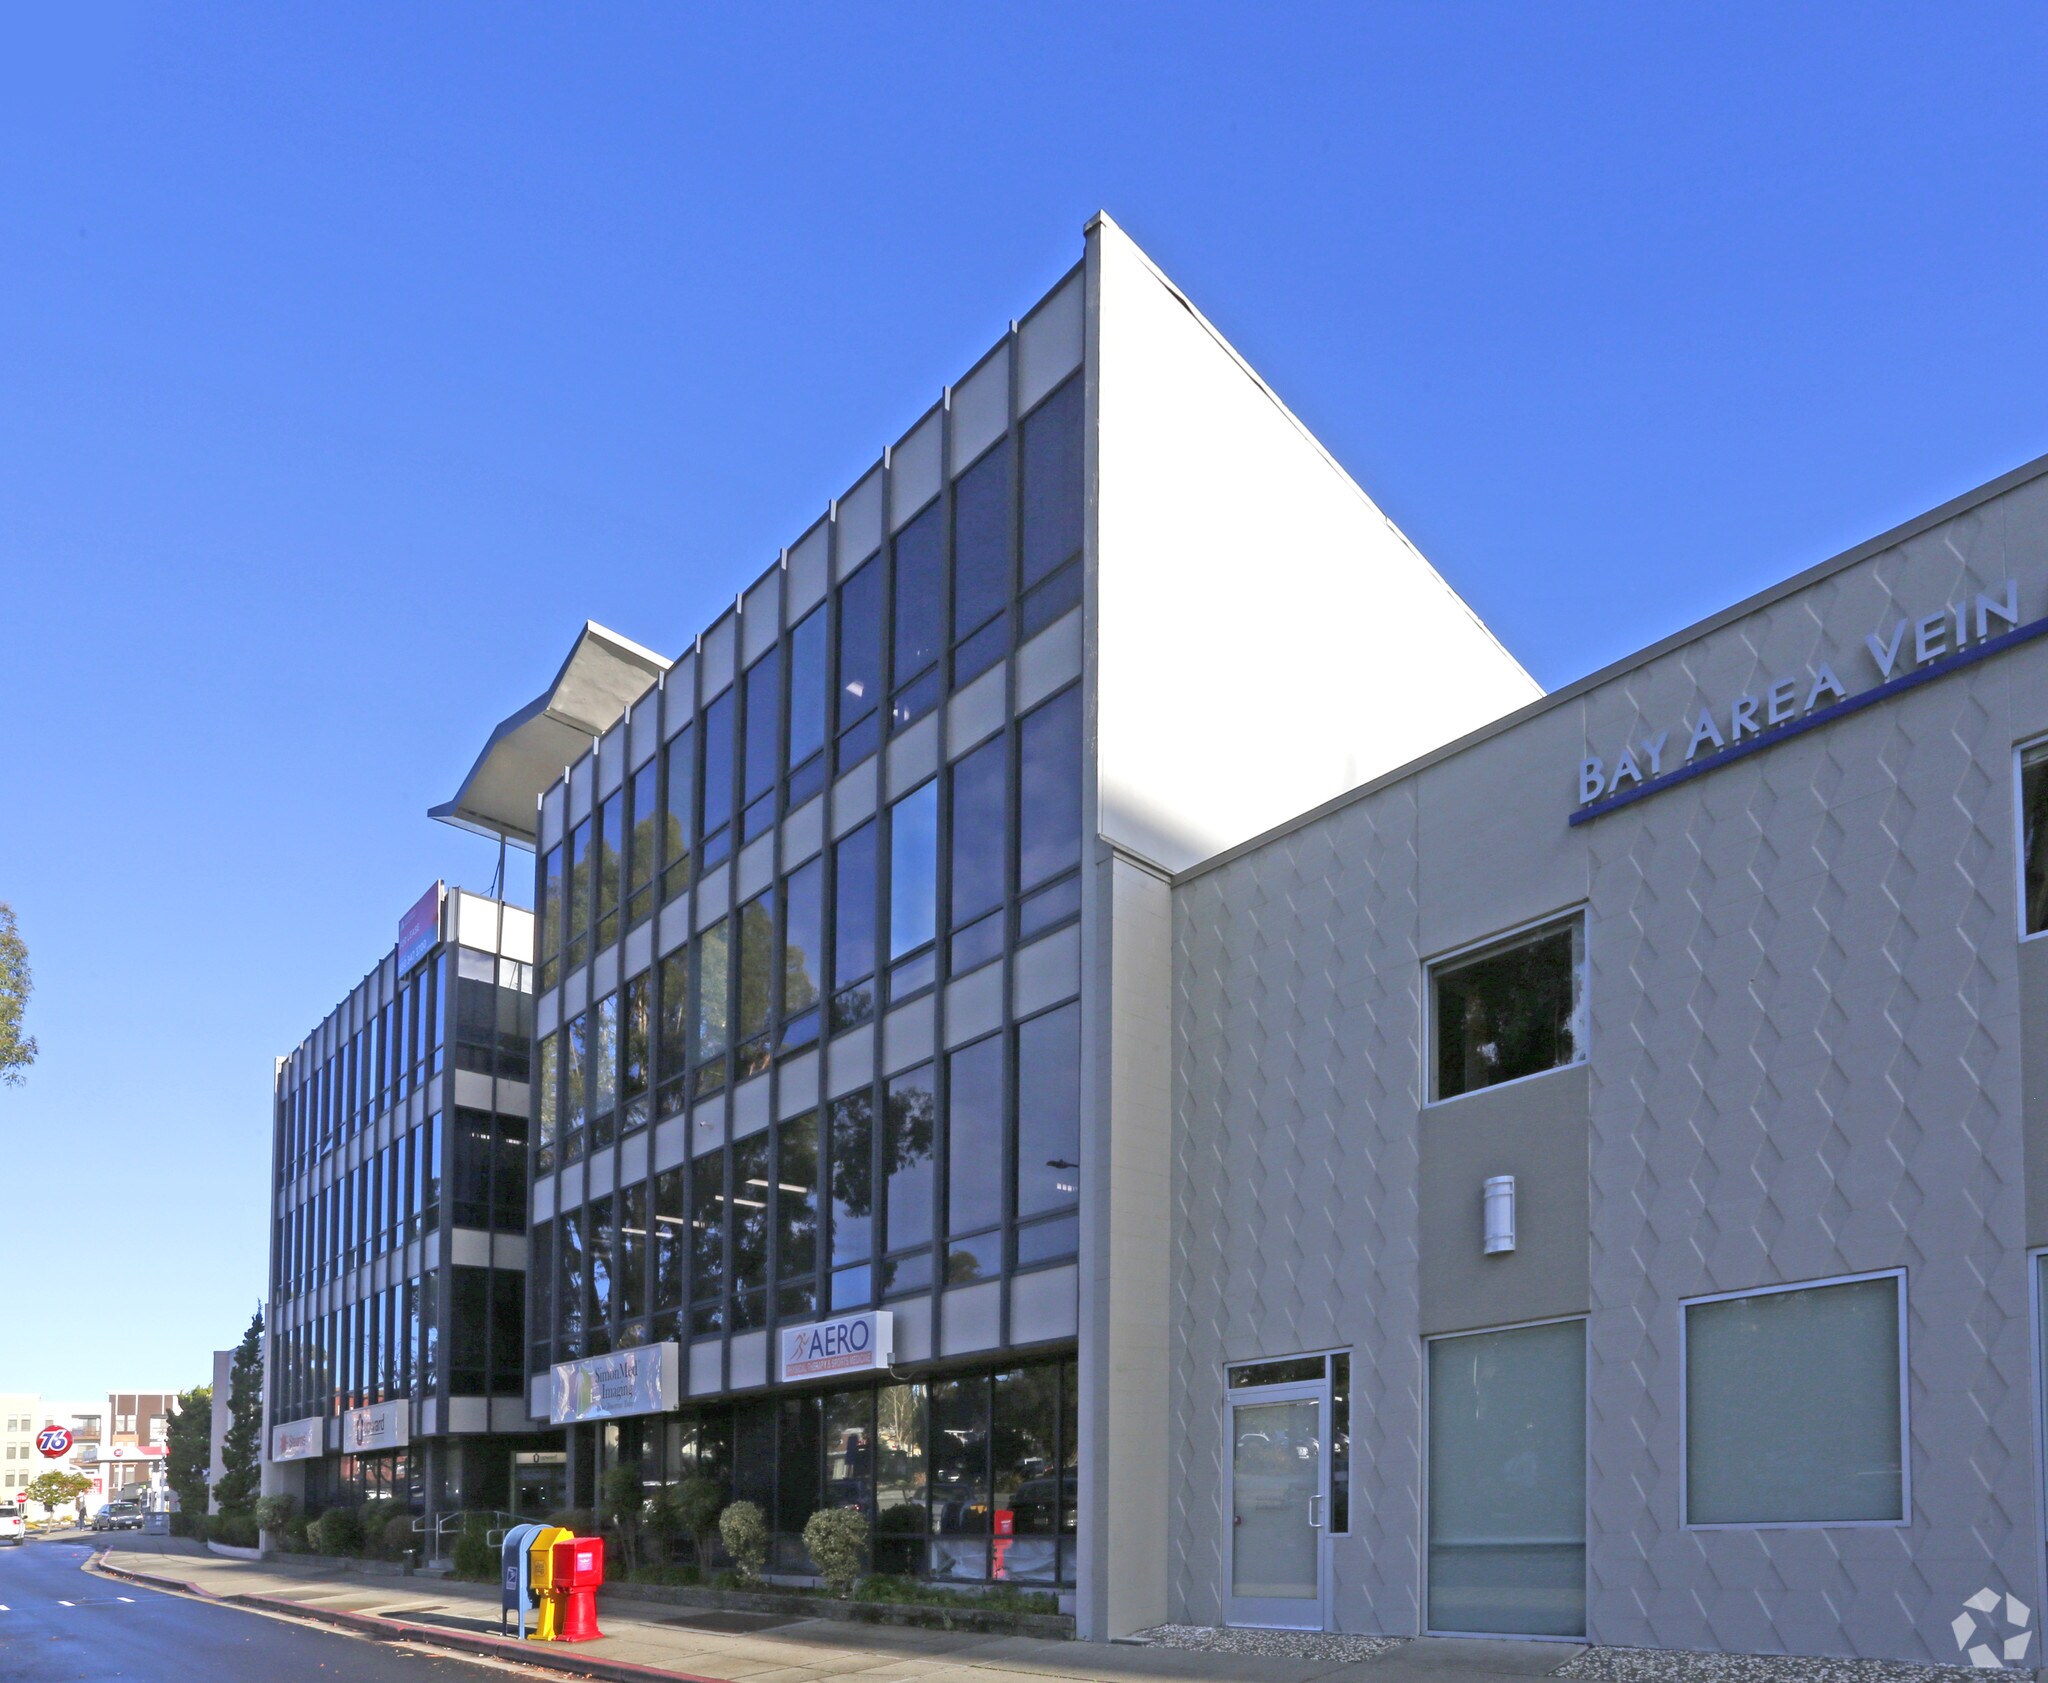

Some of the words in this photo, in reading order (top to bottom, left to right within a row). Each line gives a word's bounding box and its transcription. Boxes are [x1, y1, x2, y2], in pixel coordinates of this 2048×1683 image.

[1579, 730, 1670, 805] BAY
[1685, 661, 1848, 762] AREA
[1865, 578, 2019, 679] VEIN
[809, 1320, 869, 1359] AERO
[595, 1360, 638, 1383] SimonMed
[602, 1384, 634, 1400] Imaging
[39, 1429, 68, 1451] 76
